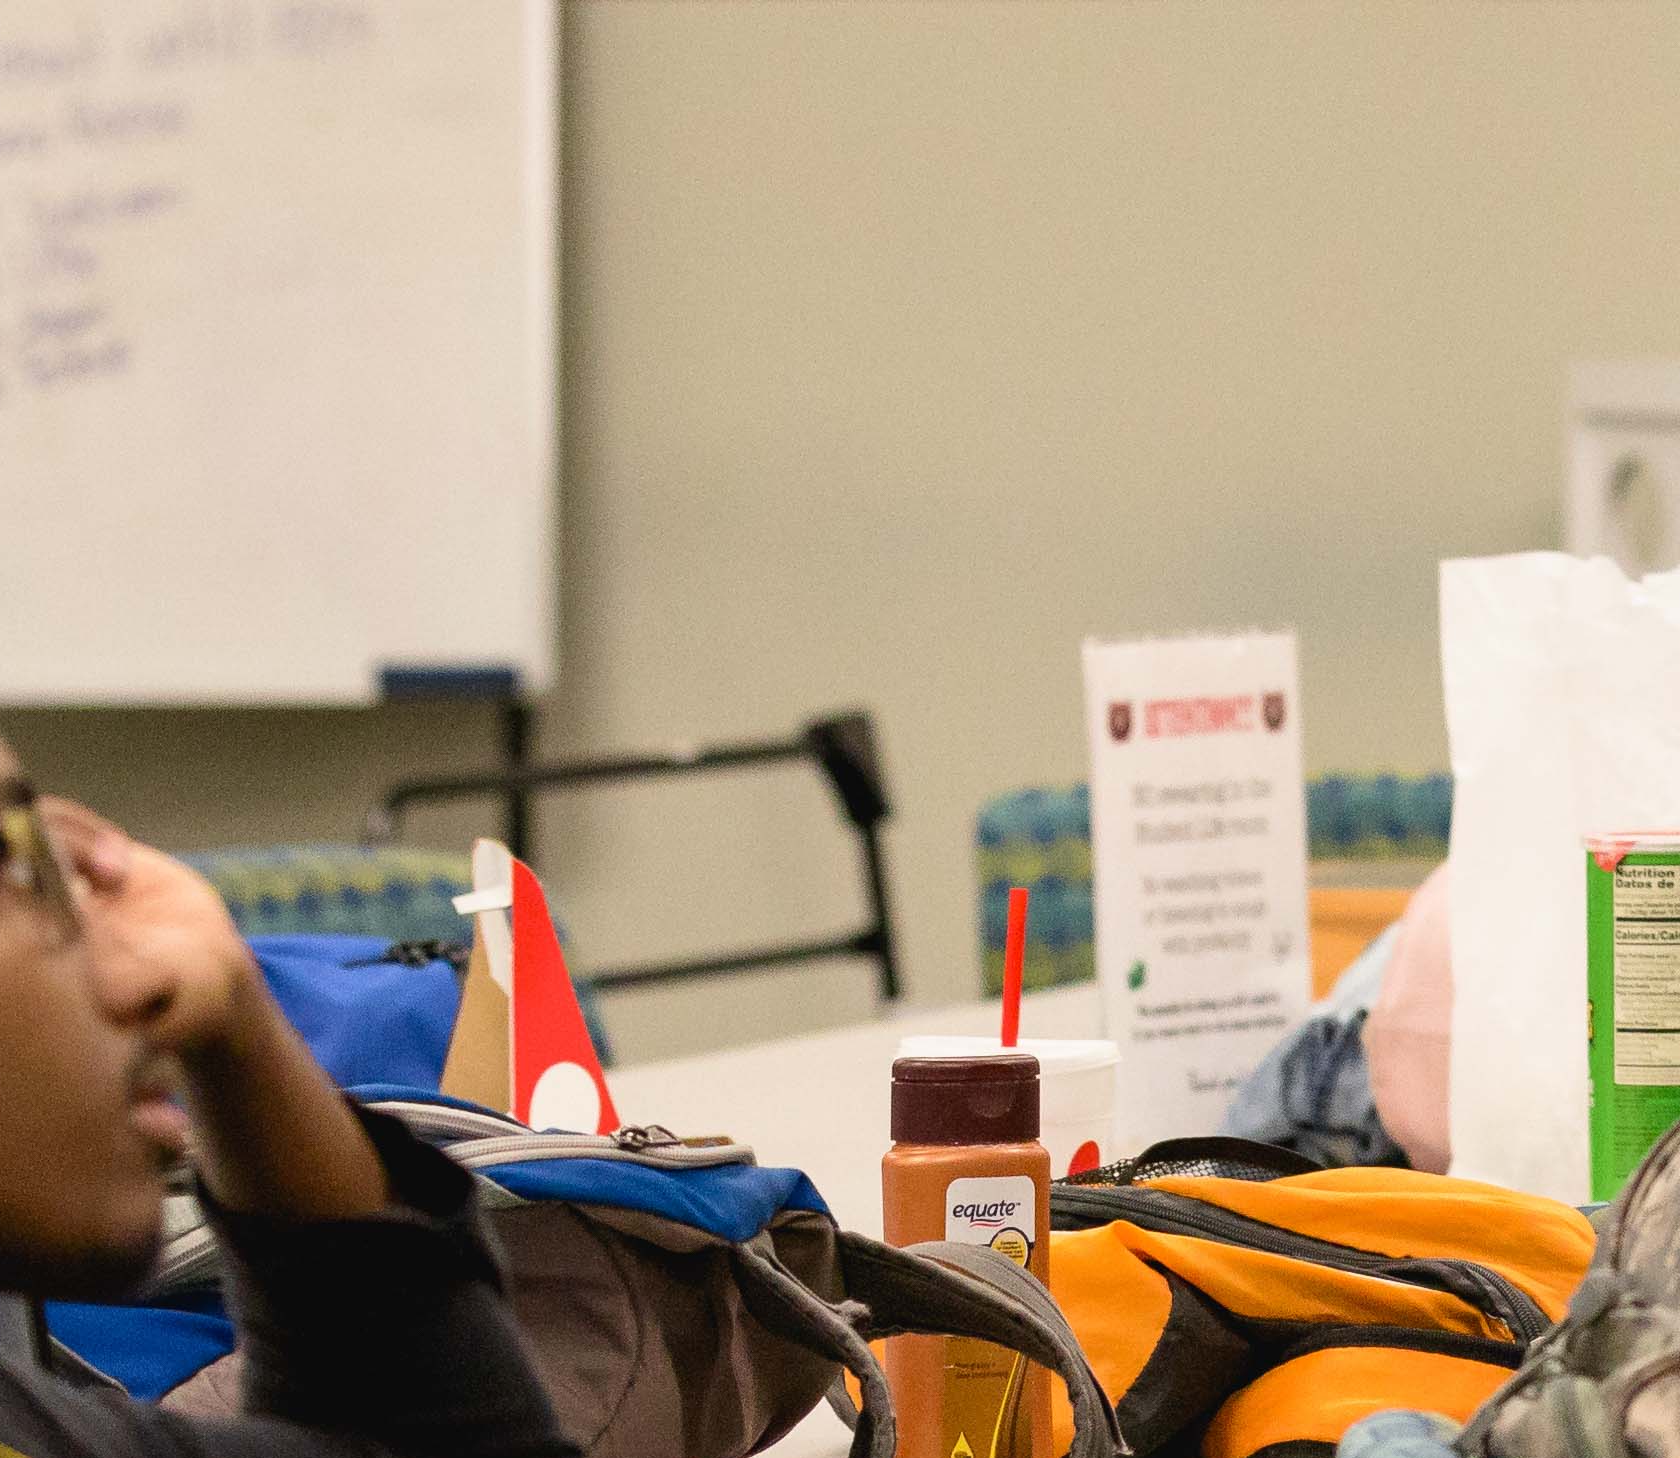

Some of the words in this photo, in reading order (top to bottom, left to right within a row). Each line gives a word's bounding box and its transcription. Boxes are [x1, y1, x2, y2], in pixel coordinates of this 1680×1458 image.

[1616, 867, 1675, 879] Nutrition
[1616, 879, 1653, 889] Datos
[1658, 879, 1674, 889] de
[952, 1200, 1016, 1223] equate
